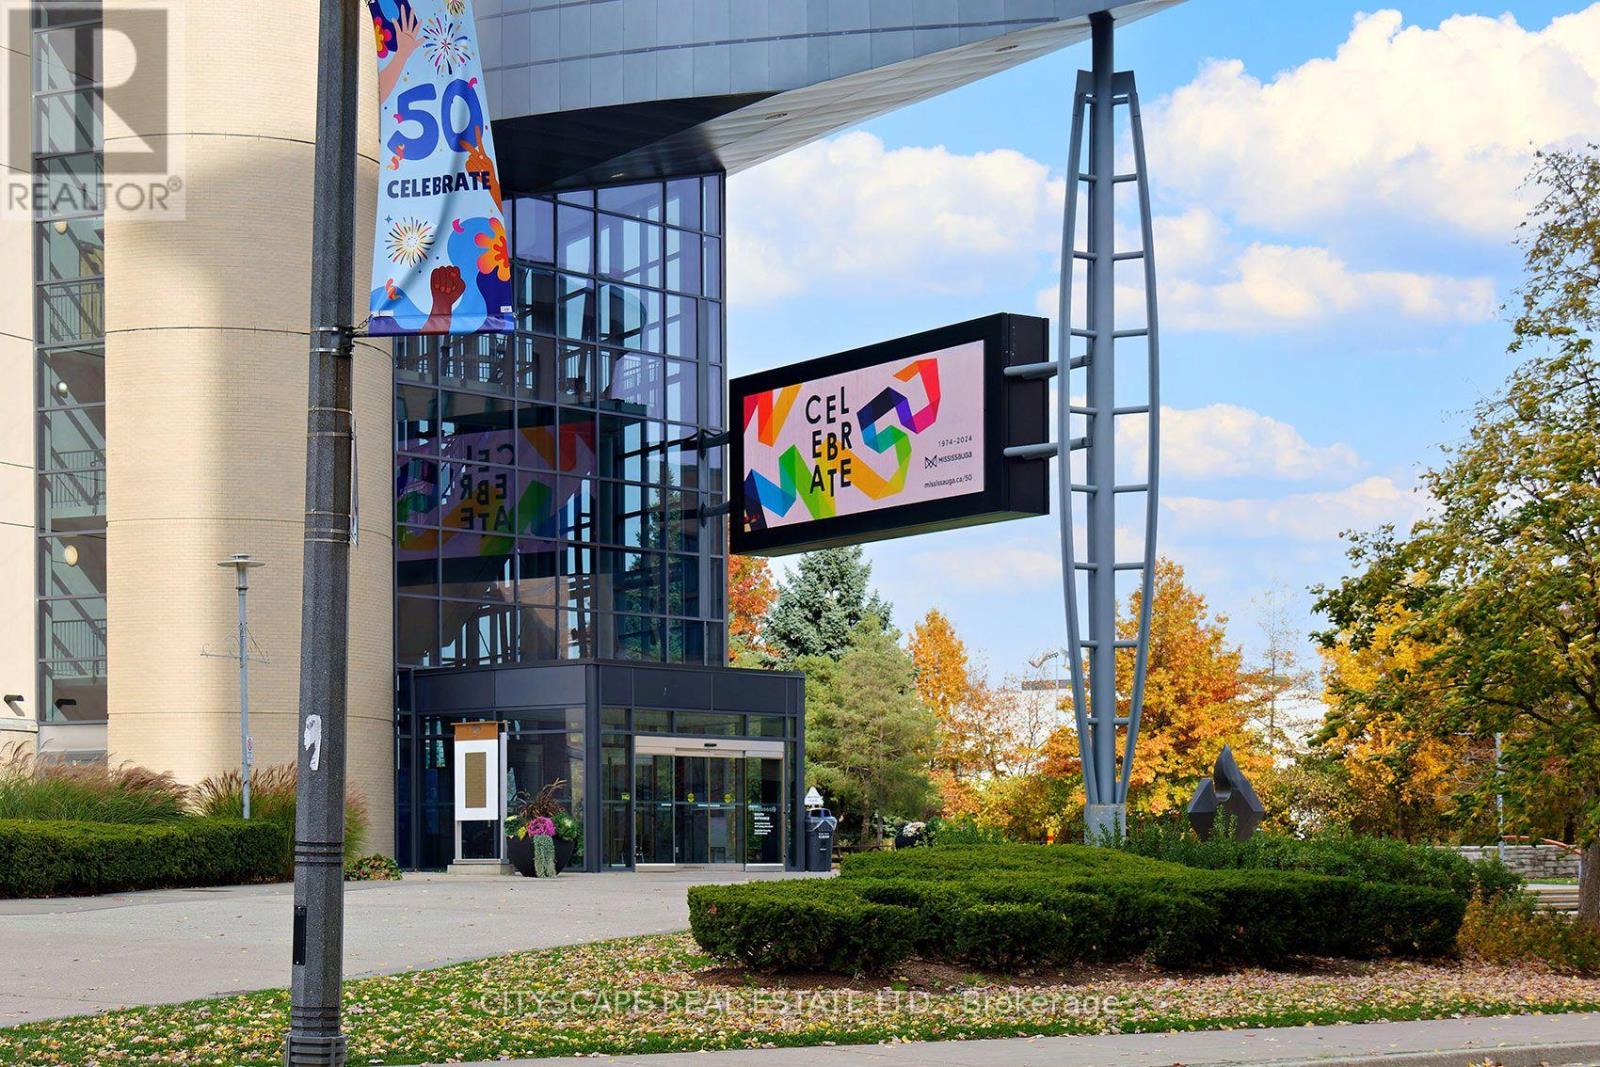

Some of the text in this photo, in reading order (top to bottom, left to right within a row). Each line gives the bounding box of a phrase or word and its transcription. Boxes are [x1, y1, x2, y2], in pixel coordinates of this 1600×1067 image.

[387, 79, 484, 161] 50
[387, 171, 492, 199] CELEBRATE
[937, 434, 973, 447] 1974-2024
